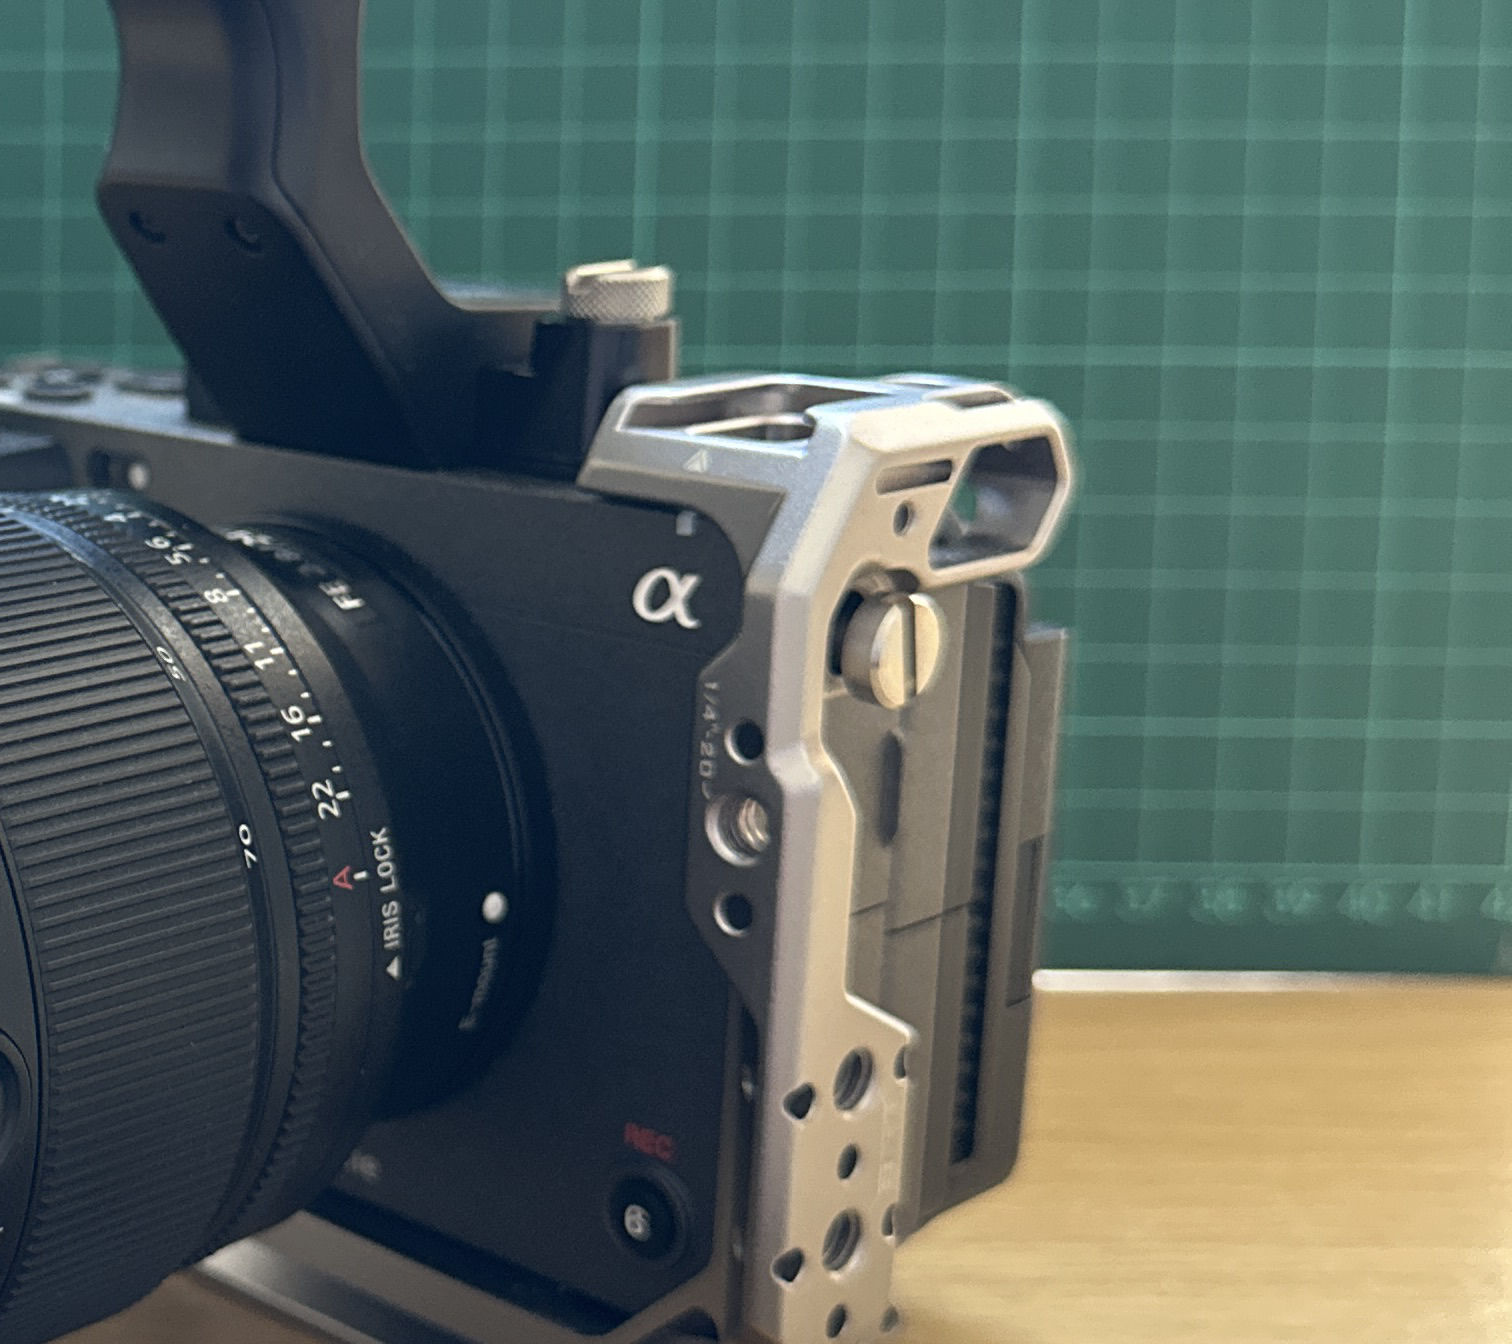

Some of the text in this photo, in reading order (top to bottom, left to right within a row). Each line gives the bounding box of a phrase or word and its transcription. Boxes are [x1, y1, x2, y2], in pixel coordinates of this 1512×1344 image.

[204, 588, 228, 604] 8
[156, 646, 186, 681] 50
[244, 641, 274, 670] 11
[281, 705, 312, 743] 16
[312, 779, 342, 821] 22
[238, 823, 258, 869] 70
[333, 865, 353, 890] A
[370, 826, 402, 949] IRIS LOCK
